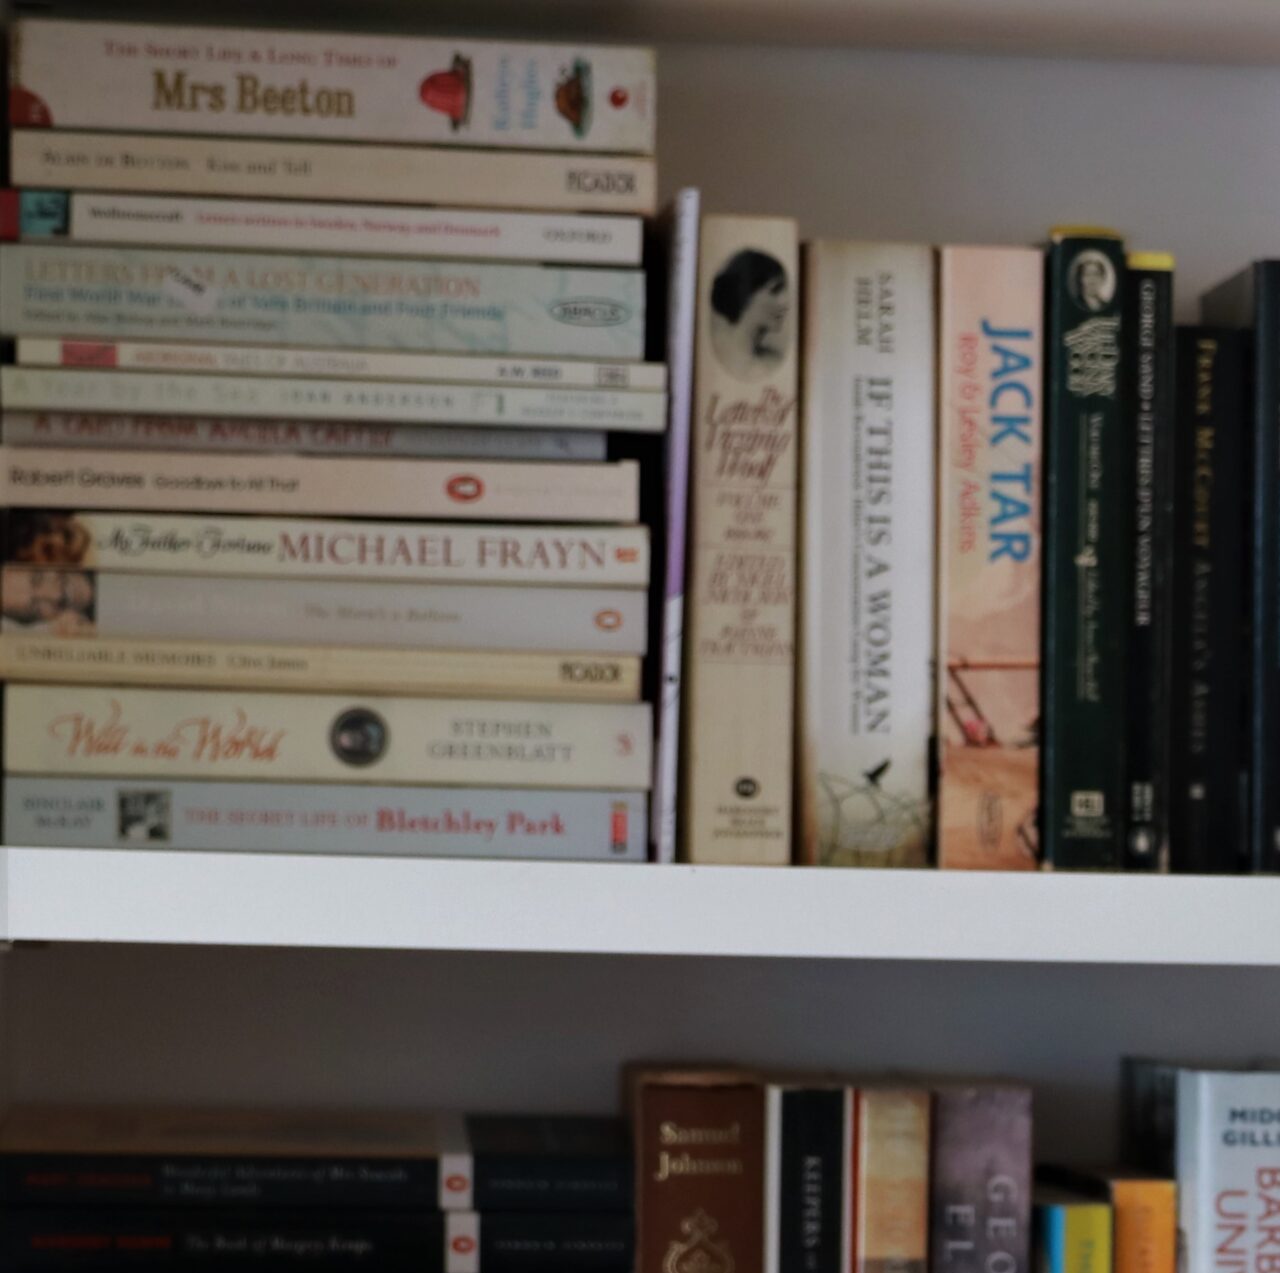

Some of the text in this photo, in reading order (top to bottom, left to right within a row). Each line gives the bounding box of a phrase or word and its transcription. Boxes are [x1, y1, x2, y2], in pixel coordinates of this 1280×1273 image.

[151, 67, 356, 119] Mrs Beeton
[565, 168, 638, 194] PICADOR
[852, 275, 873, 347] HELM
[875, 271, 895, 354] SARAH
[953, 333, 980, 379] Roy
[950, 407, 981, 472] Lesley
[978, 317, 1033, 565] JACK TAR
[957, 478, 982, 555] Adkins
[277, 530, 607, 570] MICHAEL FRAYN
[864, 375, 893, 735] IF THIS IS A WOMAN
[427, 740, 574, 761] GREENBLATT
[374, 805, 497, 842] Bletchley
[506, 807, 566, 836] Park
